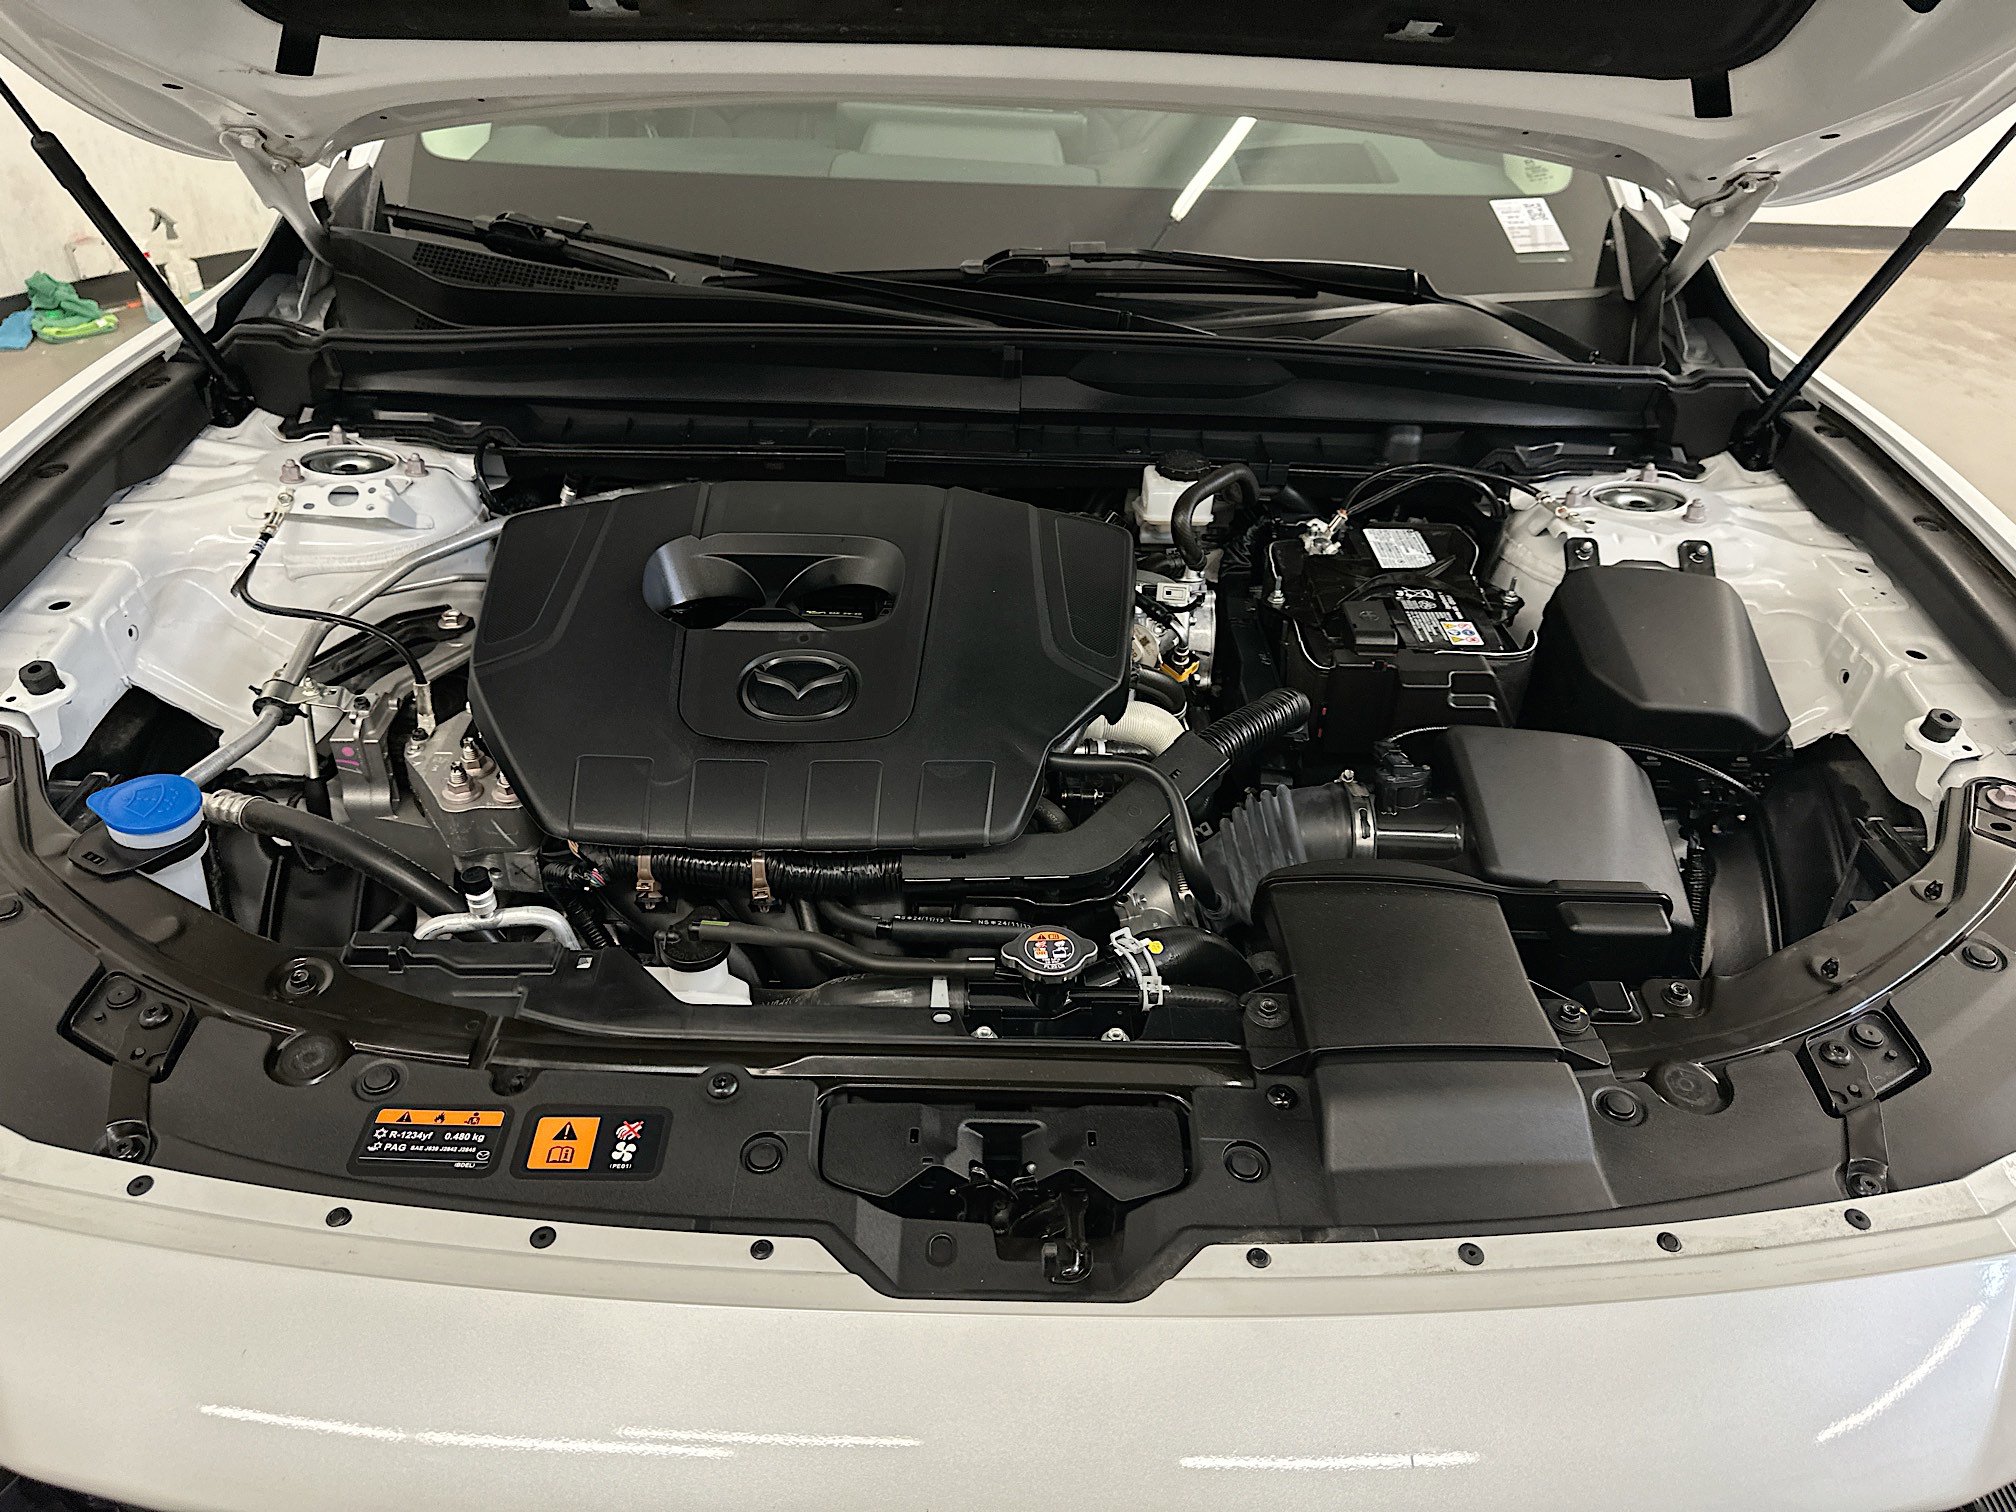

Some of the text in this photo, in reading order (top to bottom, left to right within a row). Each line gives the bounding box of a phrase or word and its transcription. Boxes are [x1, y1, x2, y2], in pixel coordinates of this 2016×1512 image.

[388, 1130, 485, 1143] R-1234yf 0.480 kg
[383, 1143, 407, 1152] PAG
